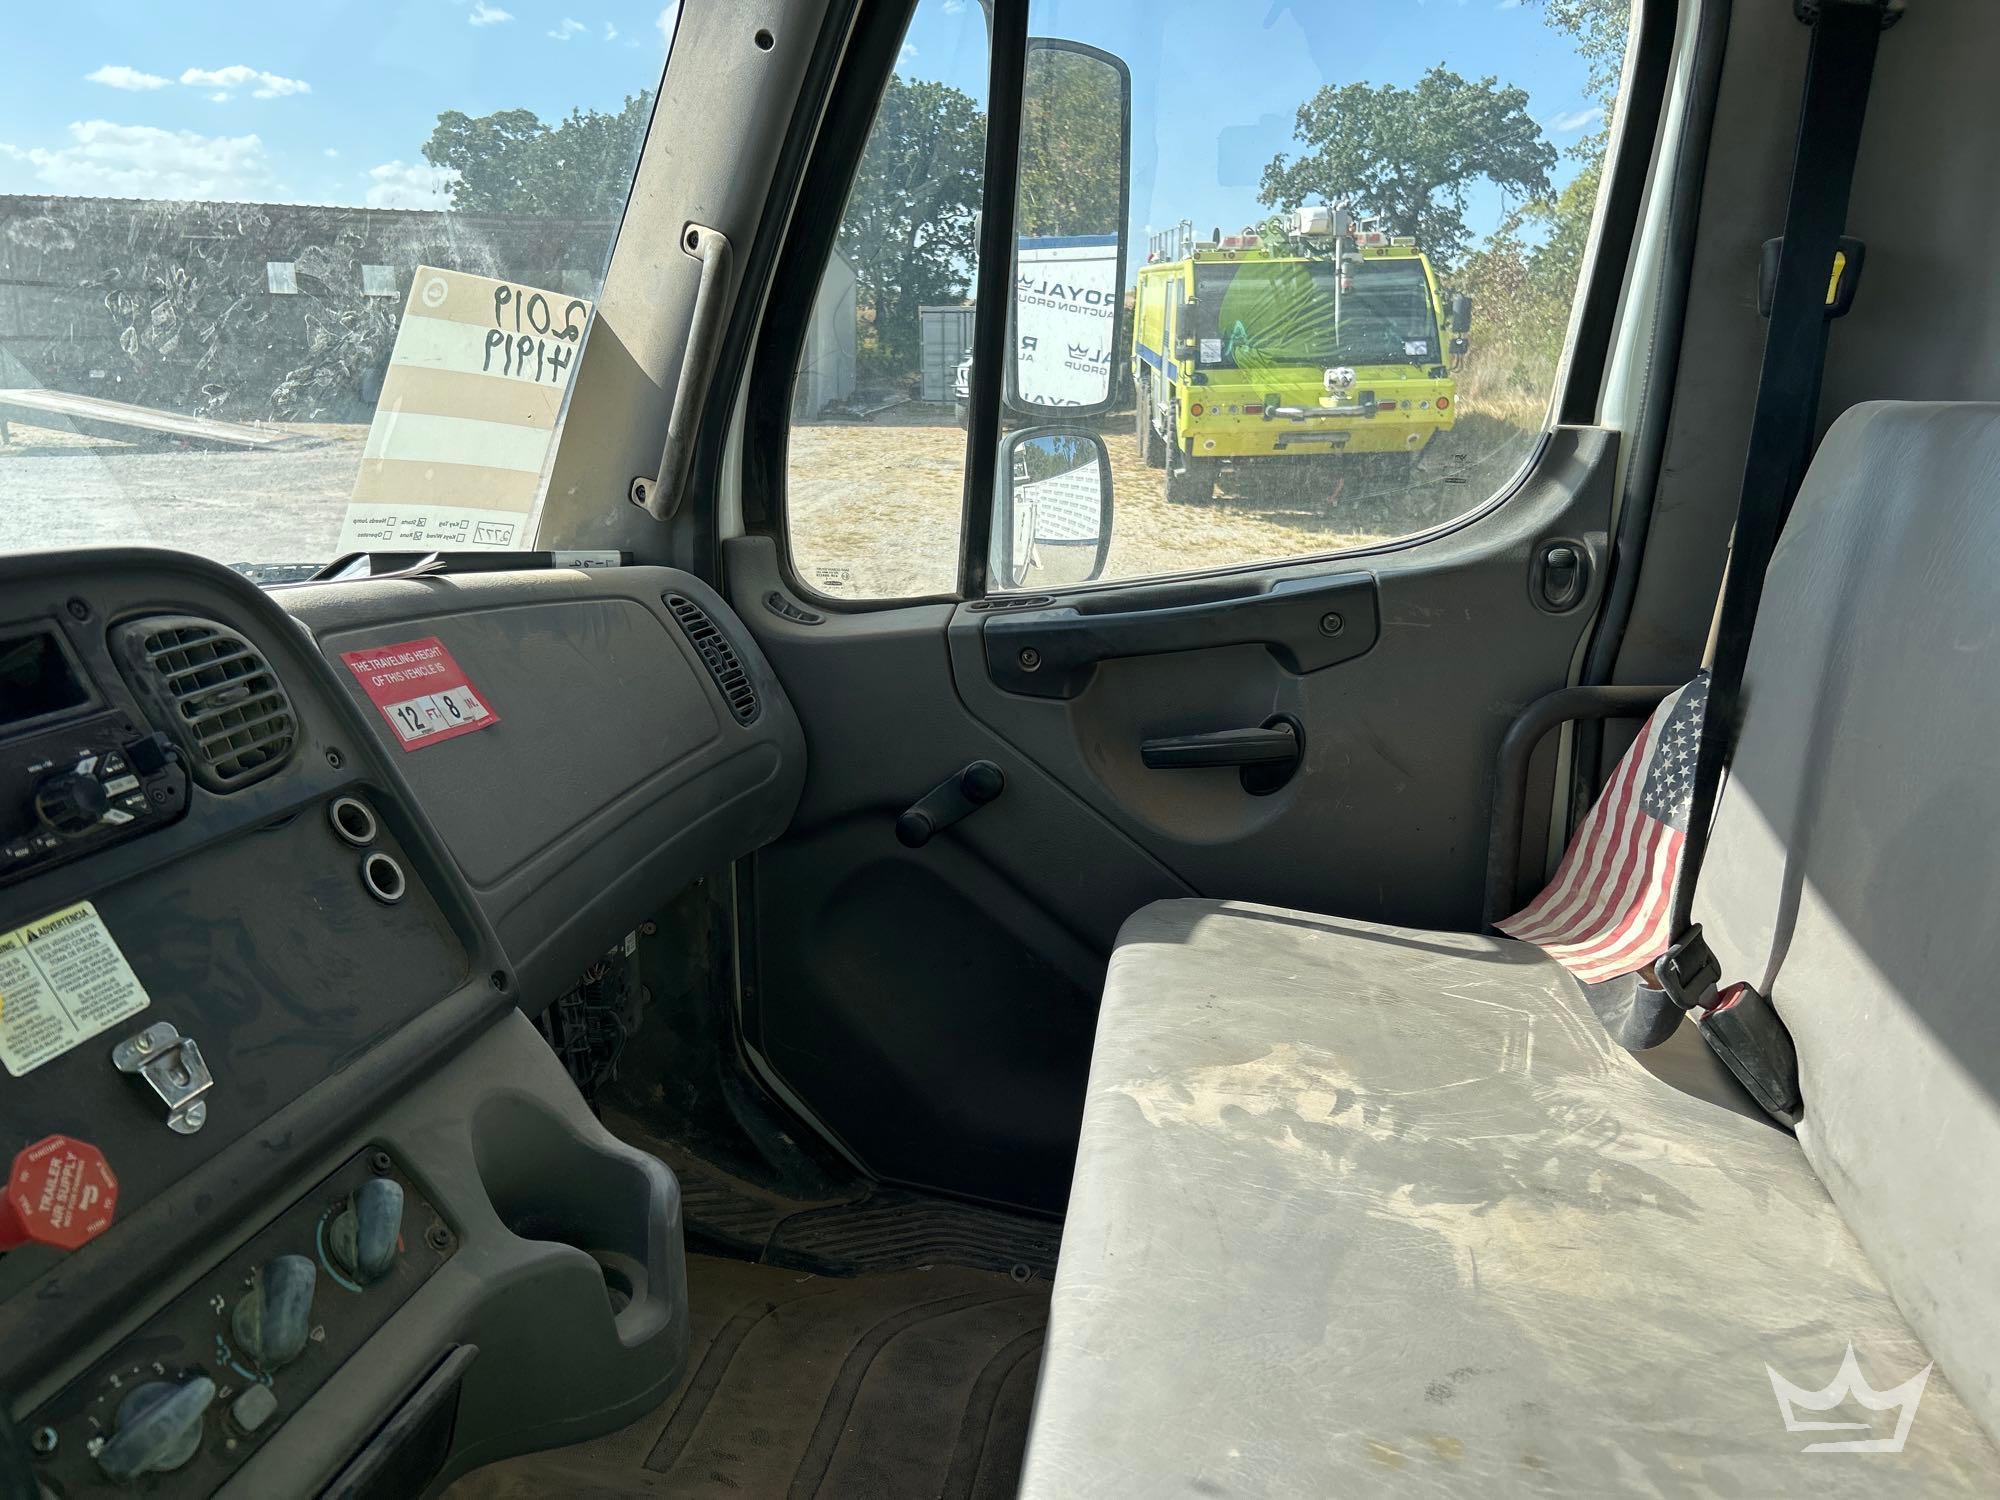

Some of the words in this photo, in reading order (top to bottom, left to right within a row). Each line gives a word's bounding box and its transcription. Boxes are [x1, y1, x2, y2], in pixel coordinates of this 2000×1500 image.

[351, 661, 372, 673] THE
[368, 653, 415, 670] TRAVELING
[412, 646, 442, 661] HEIGHT
[372, 675, 386, 686] OF
[382, 671, 405, 684] THIS
[402, 664, 437, 680] VEHICLE
[434, 662, 446, 673] IS
[398, 706, 426, 731] 12
[425, 708, 441, 720] FT.
[443, 695, 461, 719] 8
[37, 909, 89, 936] ADVERTENCIA
[38, 1156, 63, 1211] TRAILER
[56, 1151, 77, 1202] SUPPLY
[50, 1203, 65, 1229] AIR
